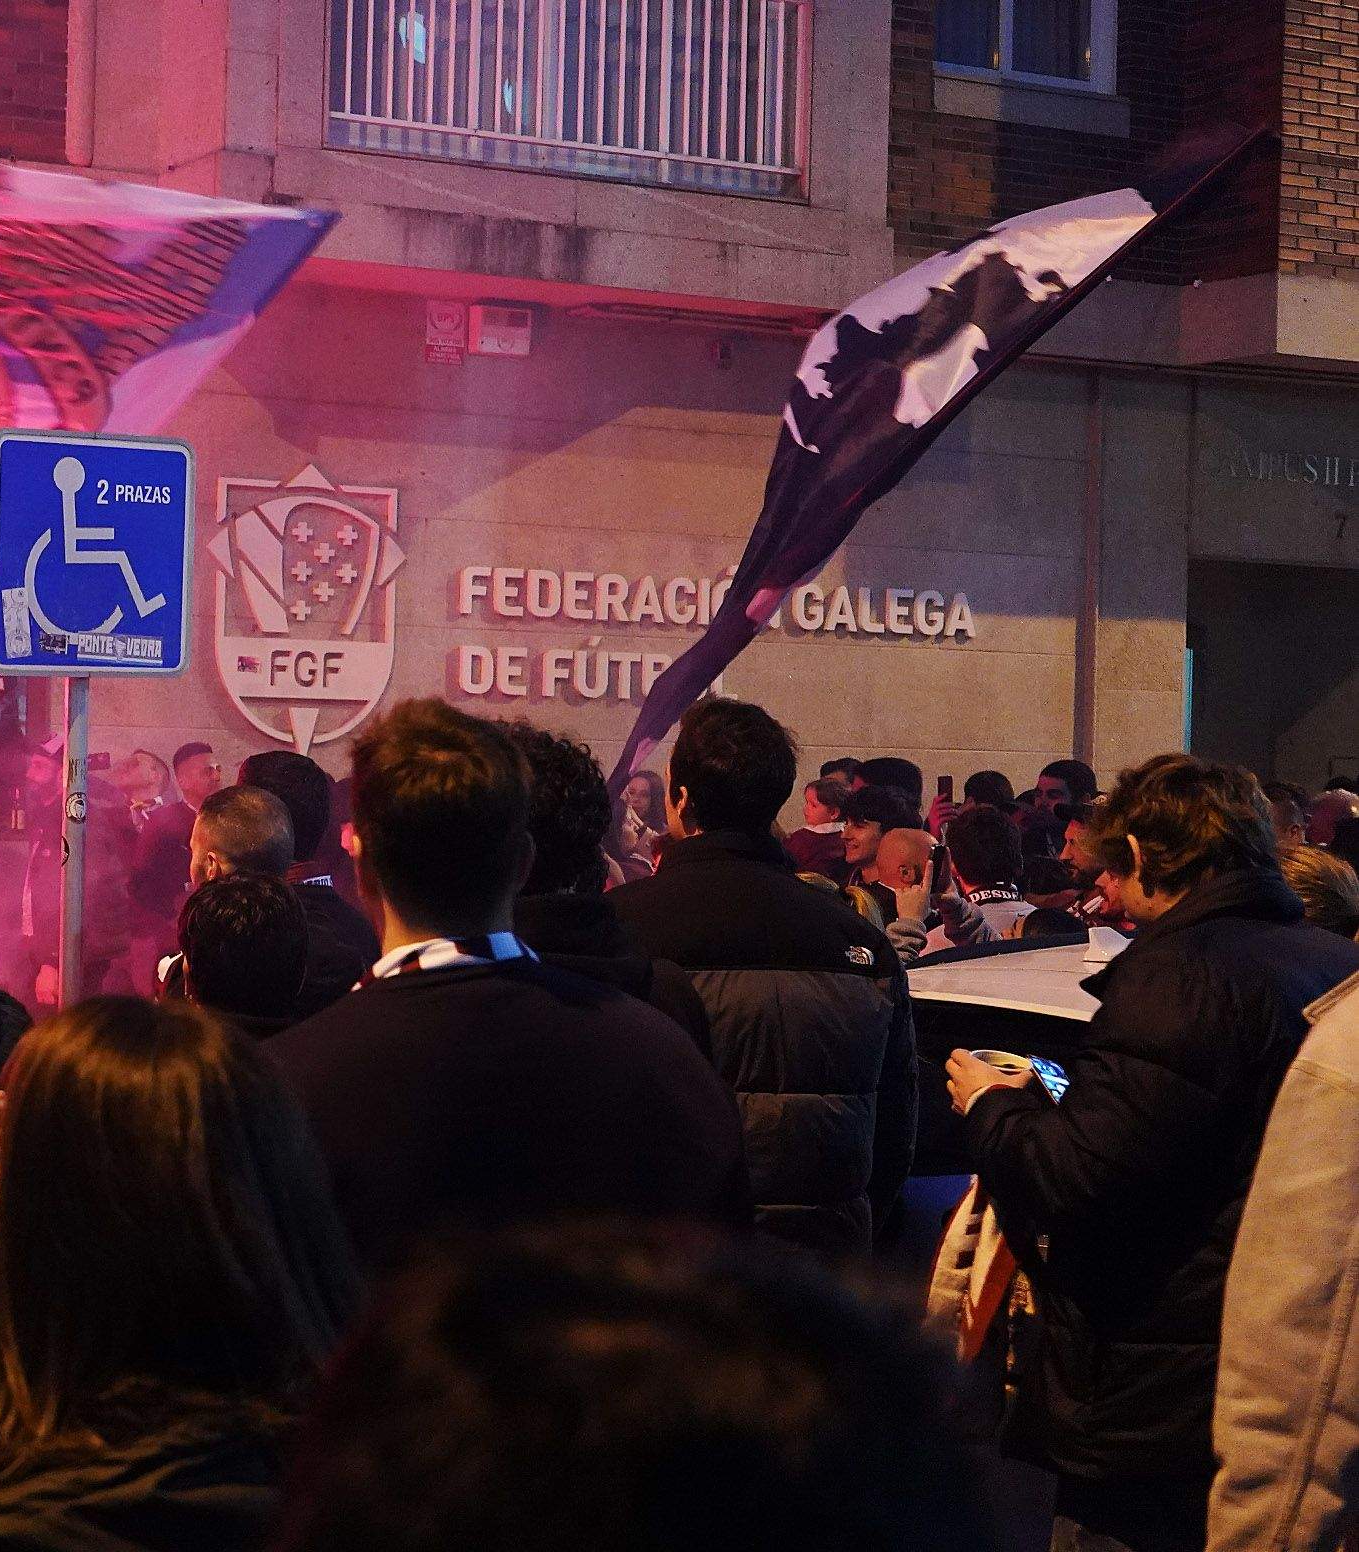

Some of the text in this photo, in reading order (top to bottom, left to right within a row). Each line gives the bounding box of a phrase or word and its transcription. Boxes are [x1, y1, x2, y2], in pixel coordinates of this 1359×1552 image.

[97, 479, 171, 504] 2 PRAZAS
[458, 565, 976, 637] FEDERACI GALEGA
[269, 650, 345, 688] FGF
[458, 636, 739, 701] DE FÚTB
[968, 889, 1019, 903] DESDE
